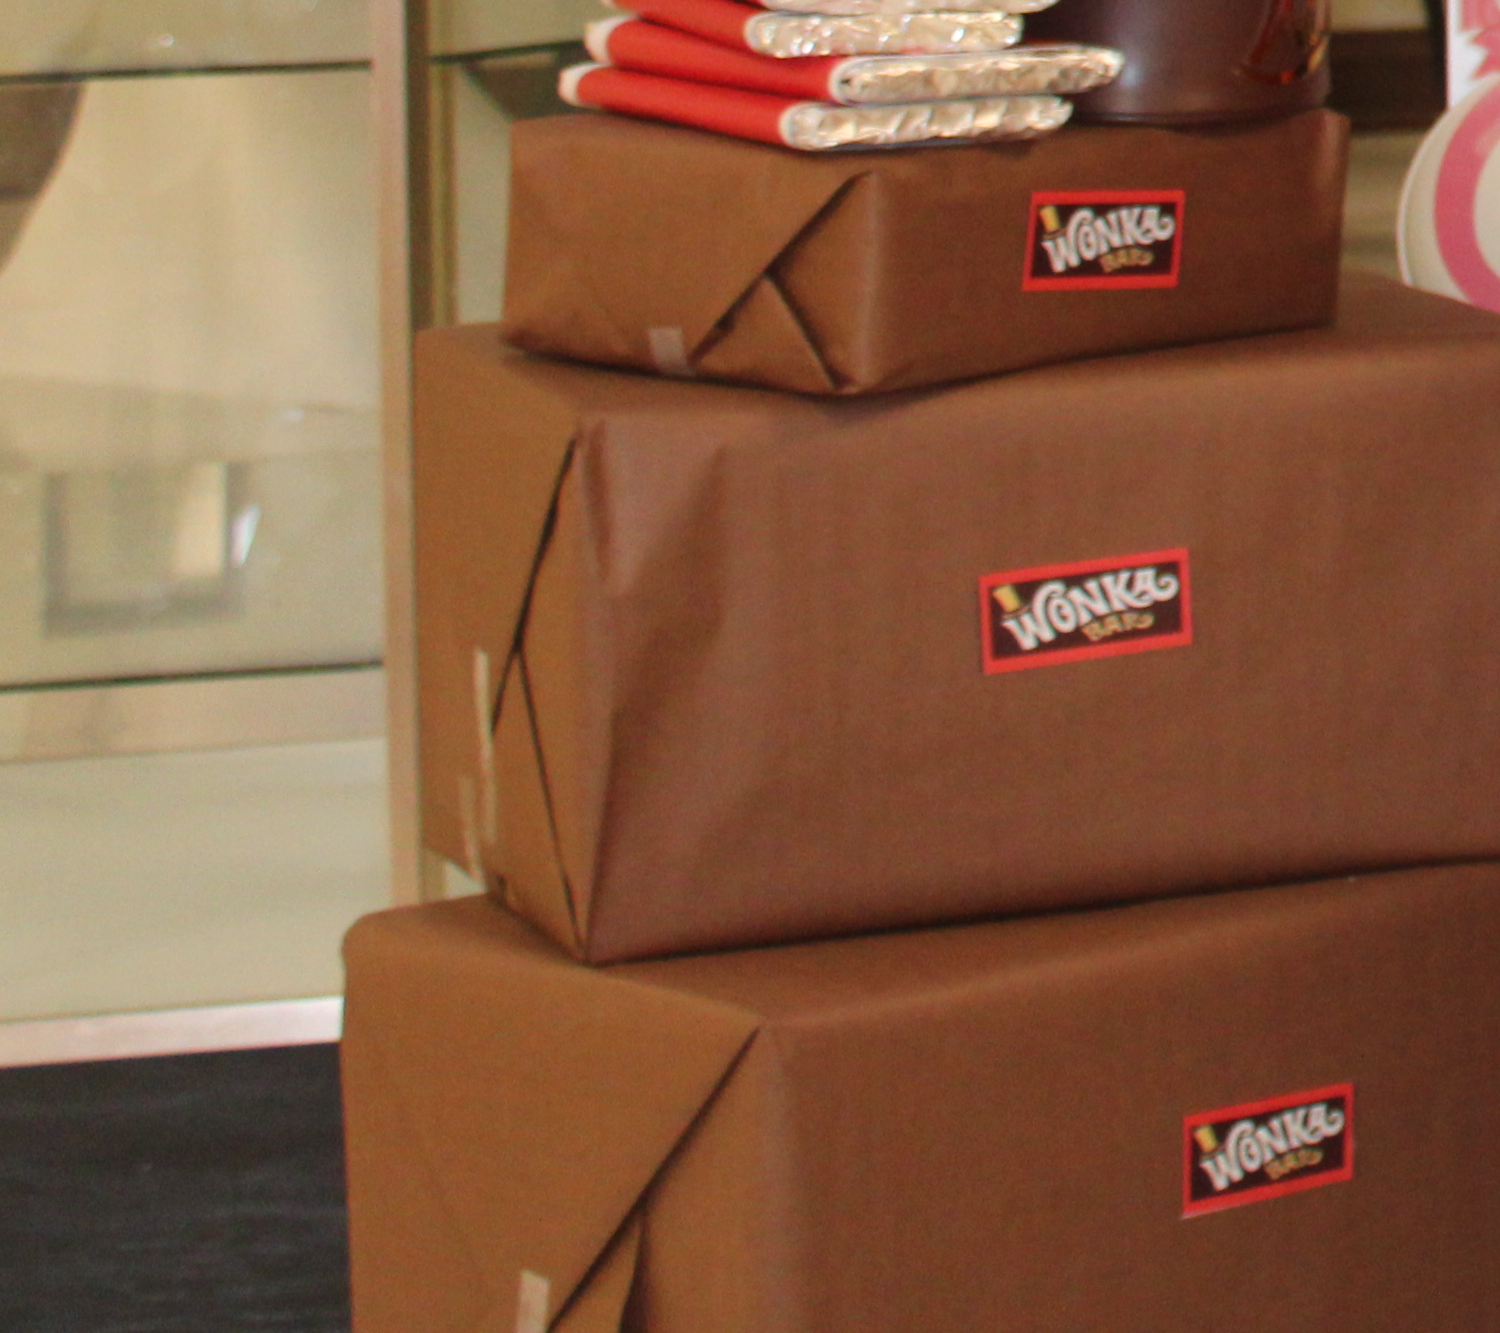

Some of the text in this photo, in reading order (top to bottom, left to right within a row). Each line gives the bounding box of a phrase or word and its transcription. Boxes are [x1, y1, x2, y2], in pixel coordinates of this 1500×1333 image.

[1041, 205, 1176, 273] WONKA
[1002, 566, 1180, 651] WONKA
[1200, 1101, 1346, 1192] WONKA
